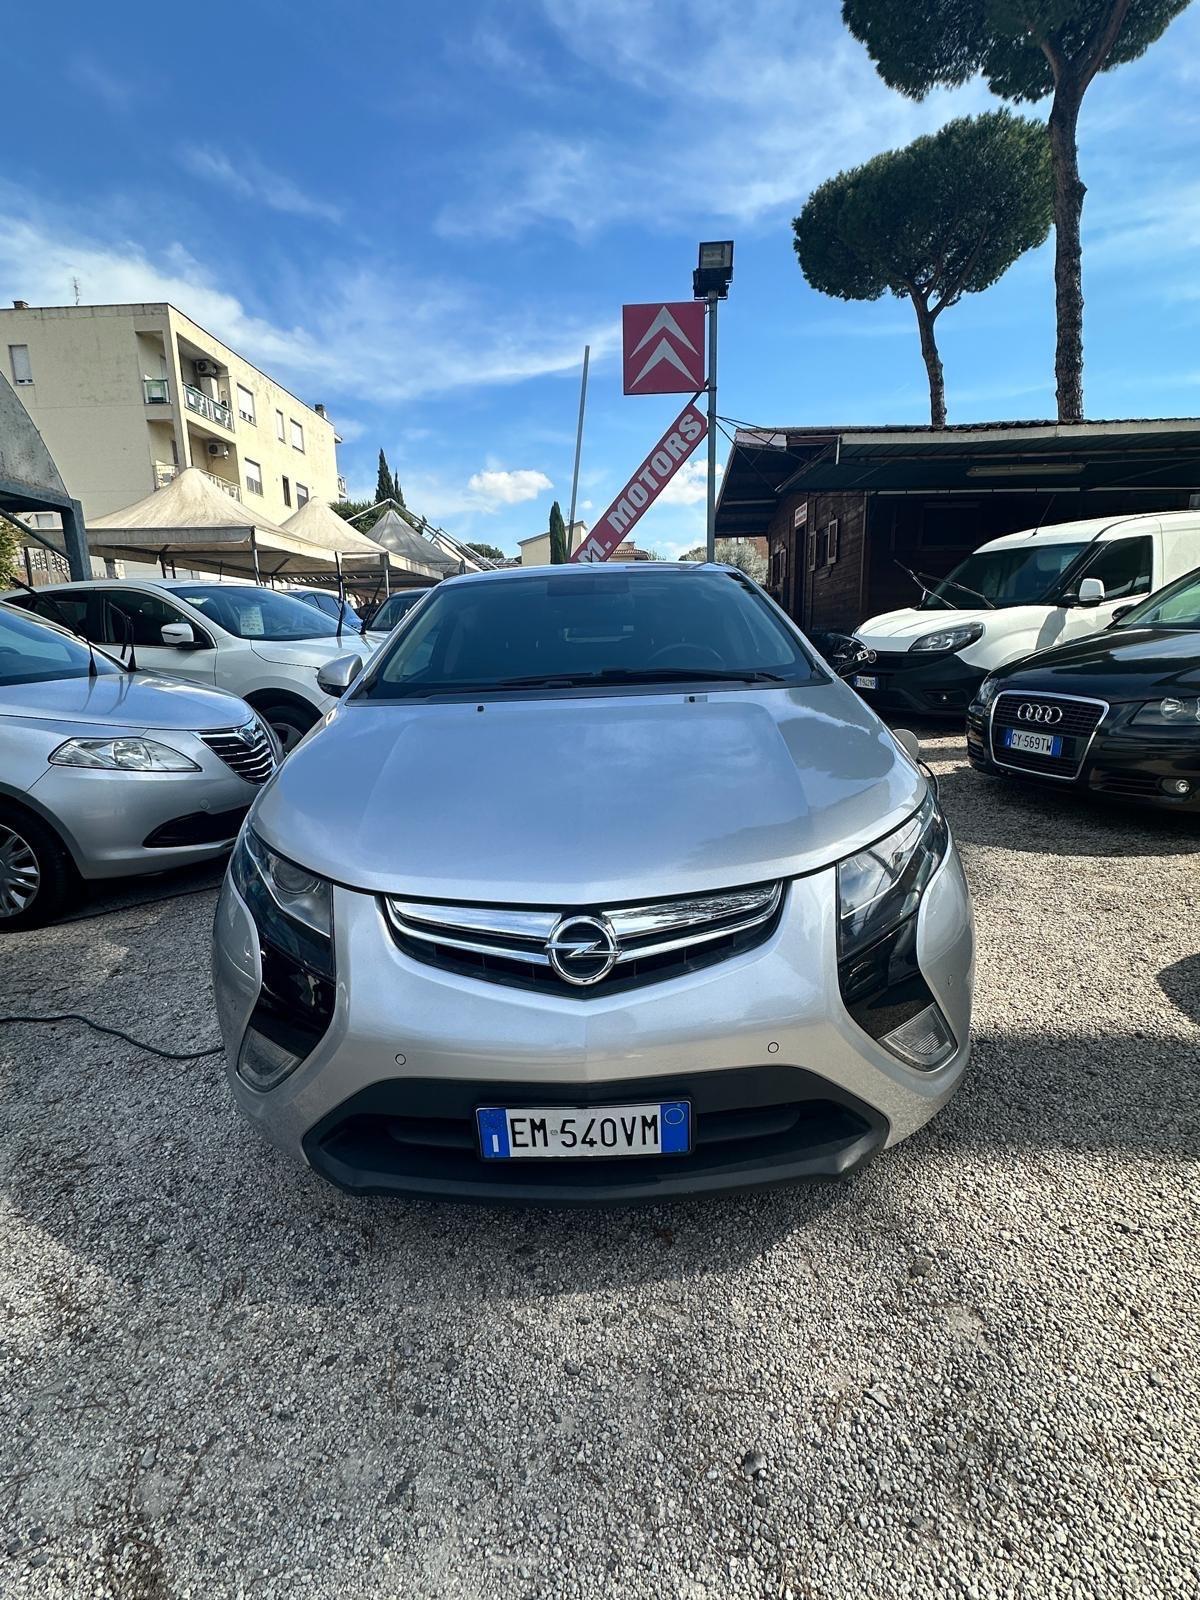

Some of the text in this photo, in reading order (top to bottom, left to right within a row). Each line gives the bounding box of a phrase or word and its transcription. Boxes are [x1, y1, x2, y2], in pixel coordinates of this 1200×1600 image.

[606, 414, 702, 534] MOTORS
[1023, 735, 1052, 752] 569TW
[510, 1117, 548, 1148] EM
[559, 1114, 658, 1148] 540VM
